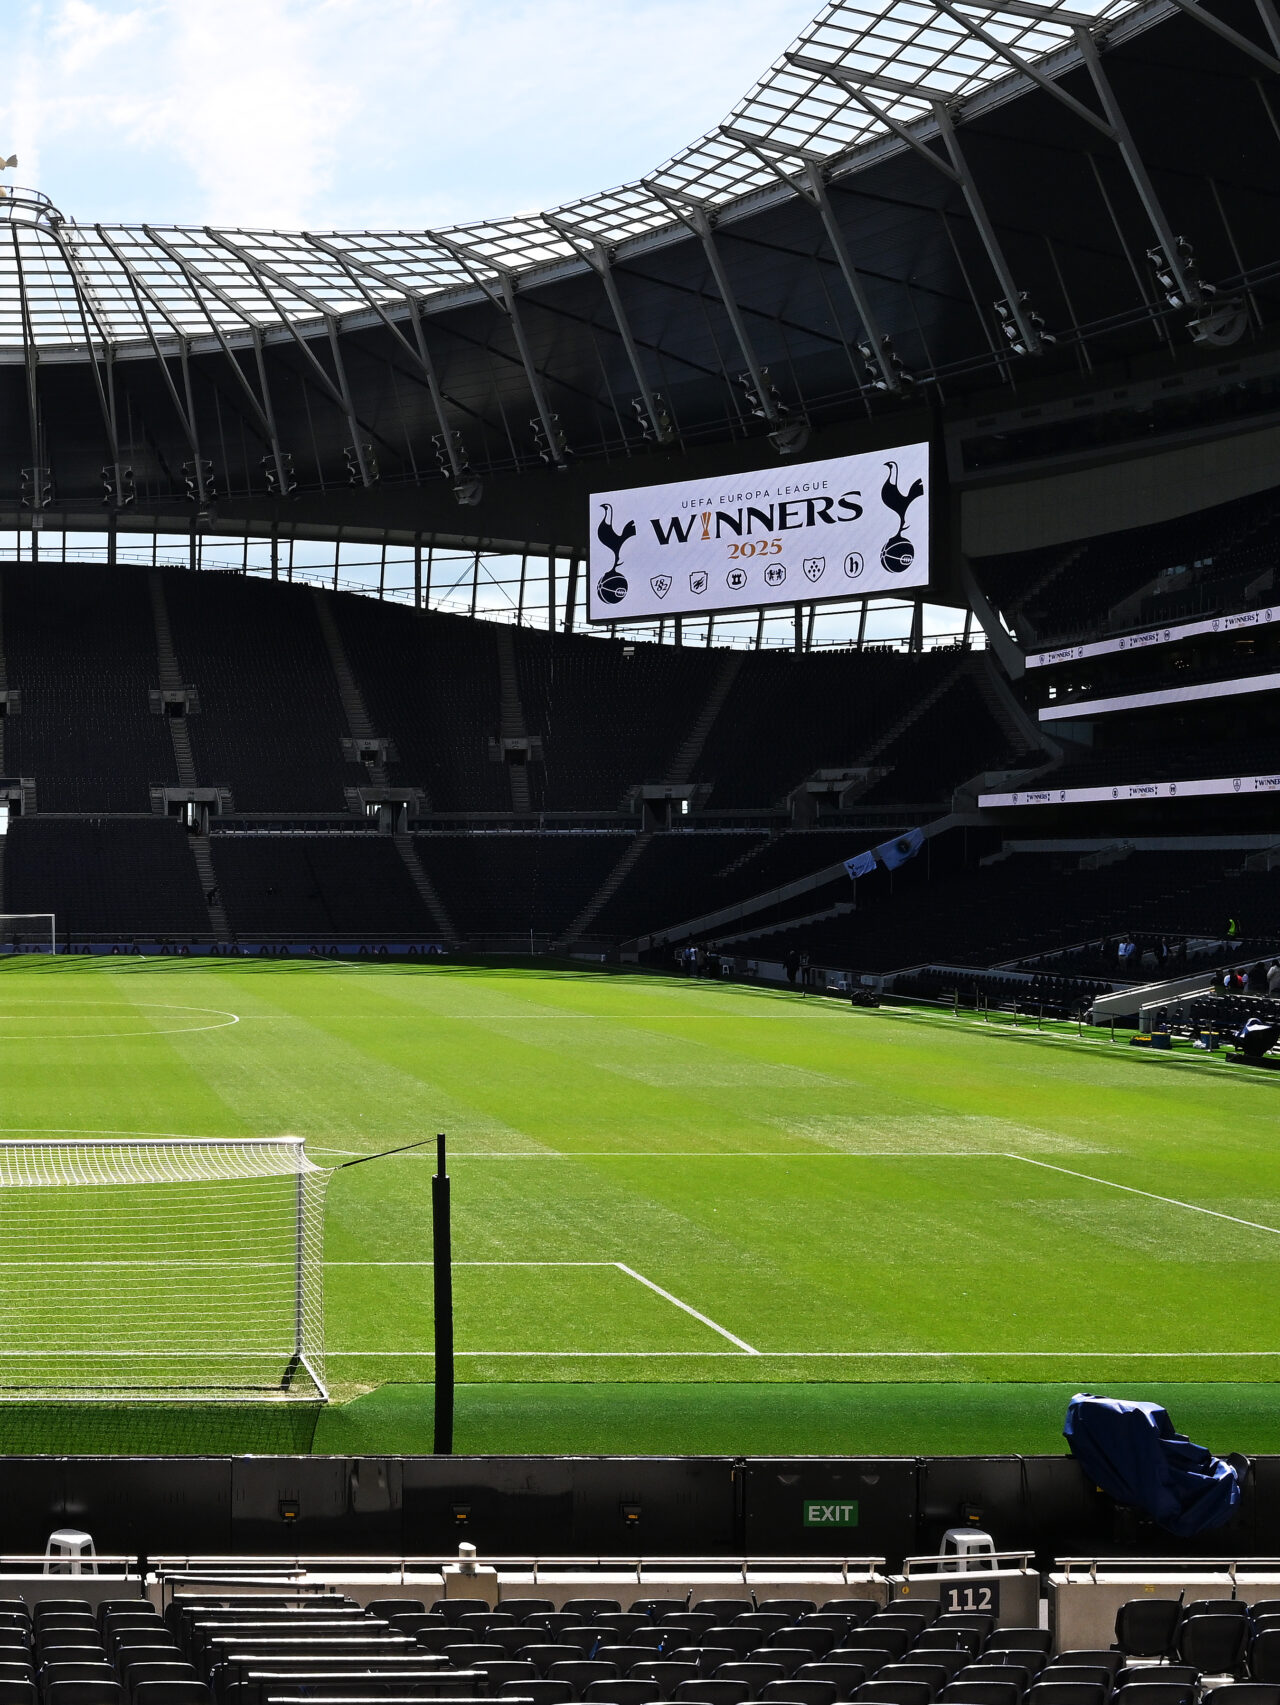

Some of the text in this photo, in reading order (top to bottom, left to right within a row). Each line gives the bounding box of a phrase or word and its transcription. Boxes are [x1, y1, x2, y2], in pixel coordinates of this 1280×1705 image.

[682, 480, 828, 509] UEFA EUROPA LEAGUE
[727, 538, 783, 560] 2025
[808, 1505, 854, 1522] EXIT
[948, 1587, 992, 1612] 112
